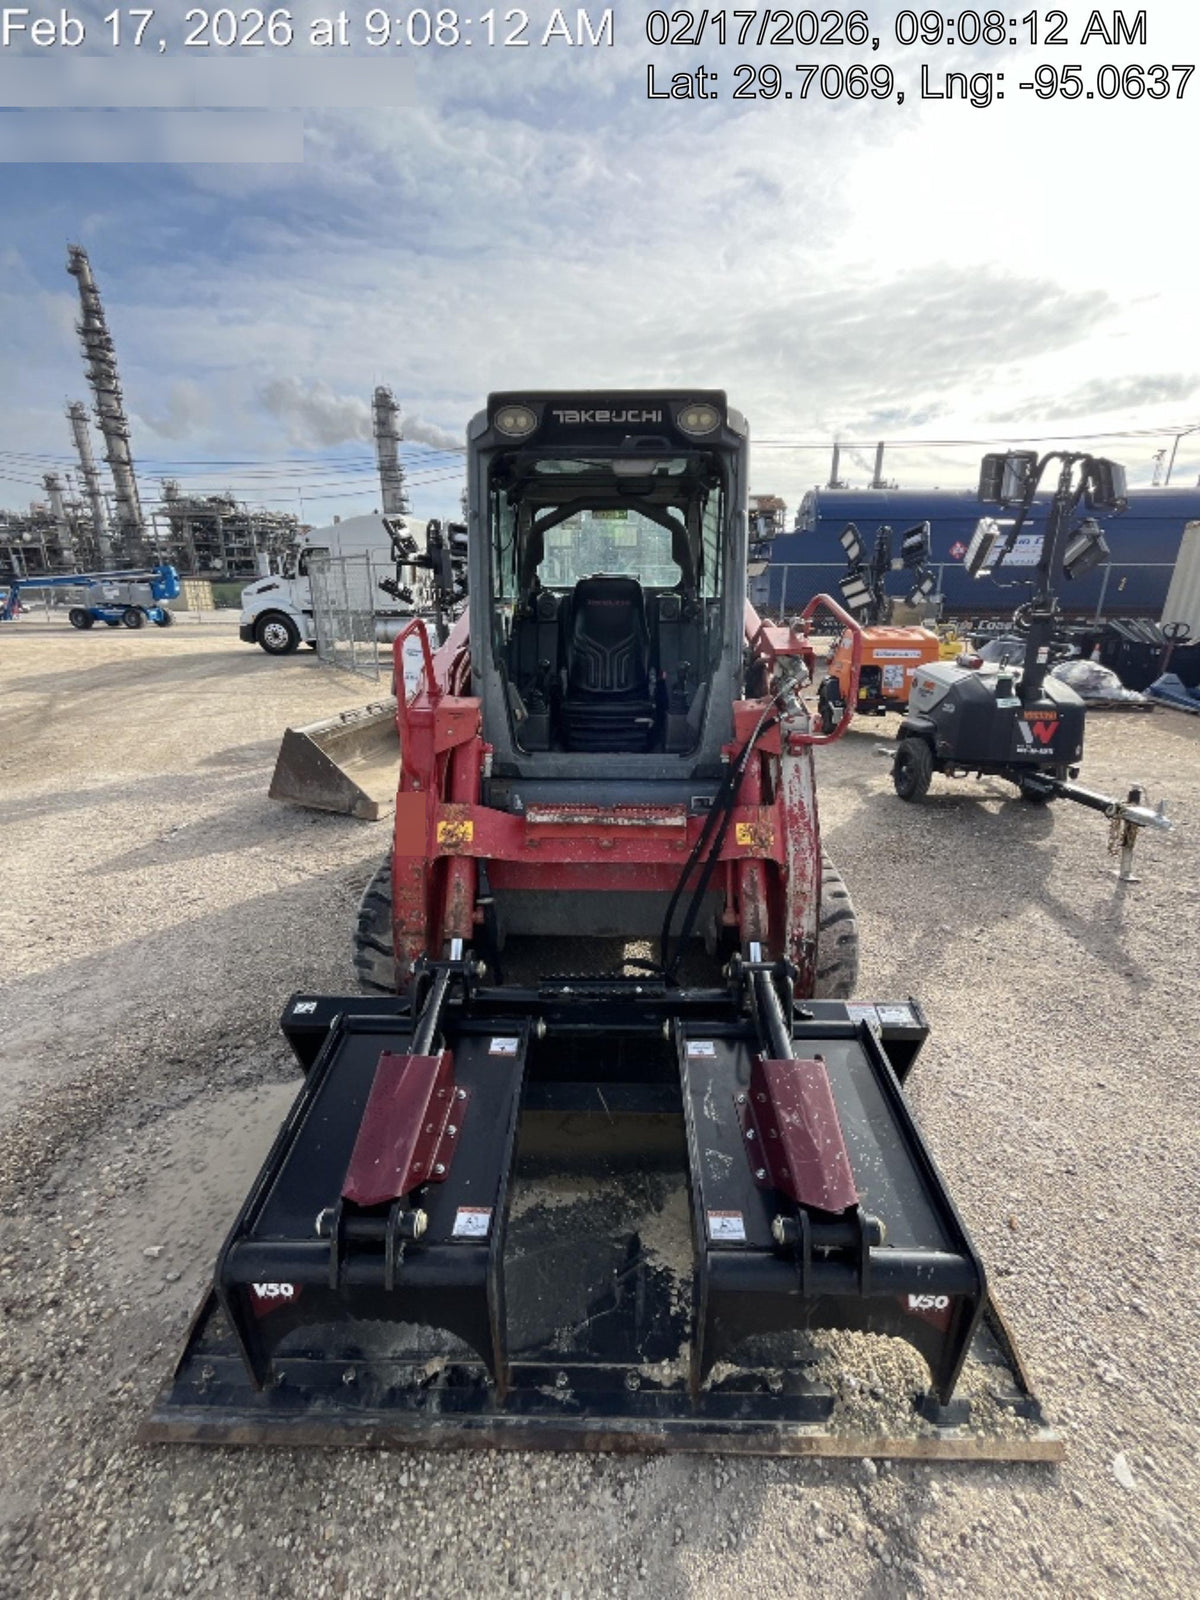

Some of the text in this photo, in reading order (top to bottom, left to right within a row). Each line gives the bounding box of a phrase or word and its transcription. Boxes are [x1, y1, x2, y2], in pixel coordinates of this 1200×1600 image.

[552, 409, 663, 424] TAKEUCHI
[251, 1282, 295, 1298] V50
[908, 1294, 950, 1310] V50
